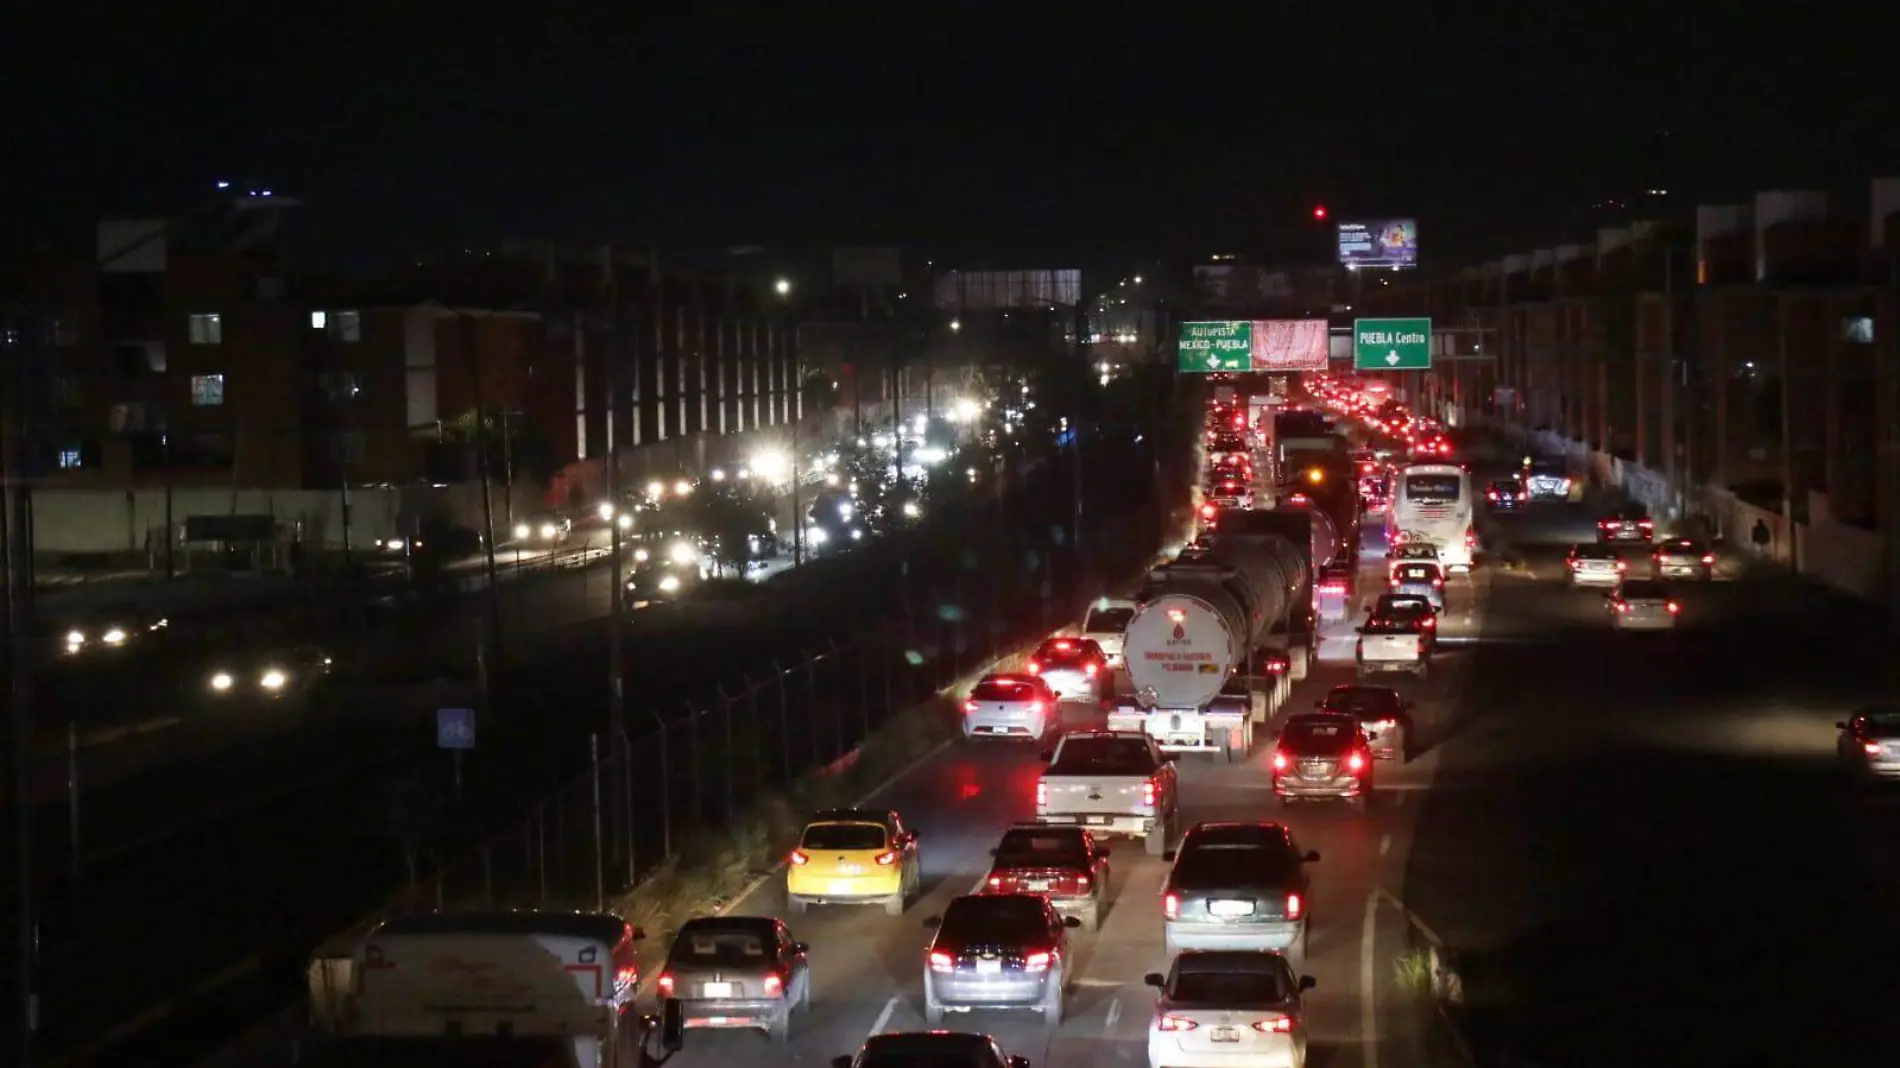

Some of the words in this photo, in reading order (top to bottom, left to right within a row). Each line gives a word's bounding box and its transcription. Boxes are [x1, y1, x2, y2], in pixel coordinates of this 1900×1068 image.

[1192, 327, 1236, 337] AUTOPISTA
[1360, 331, 1393, 344] PUEBLA
[1395, 331, 1426, 344] Centro
